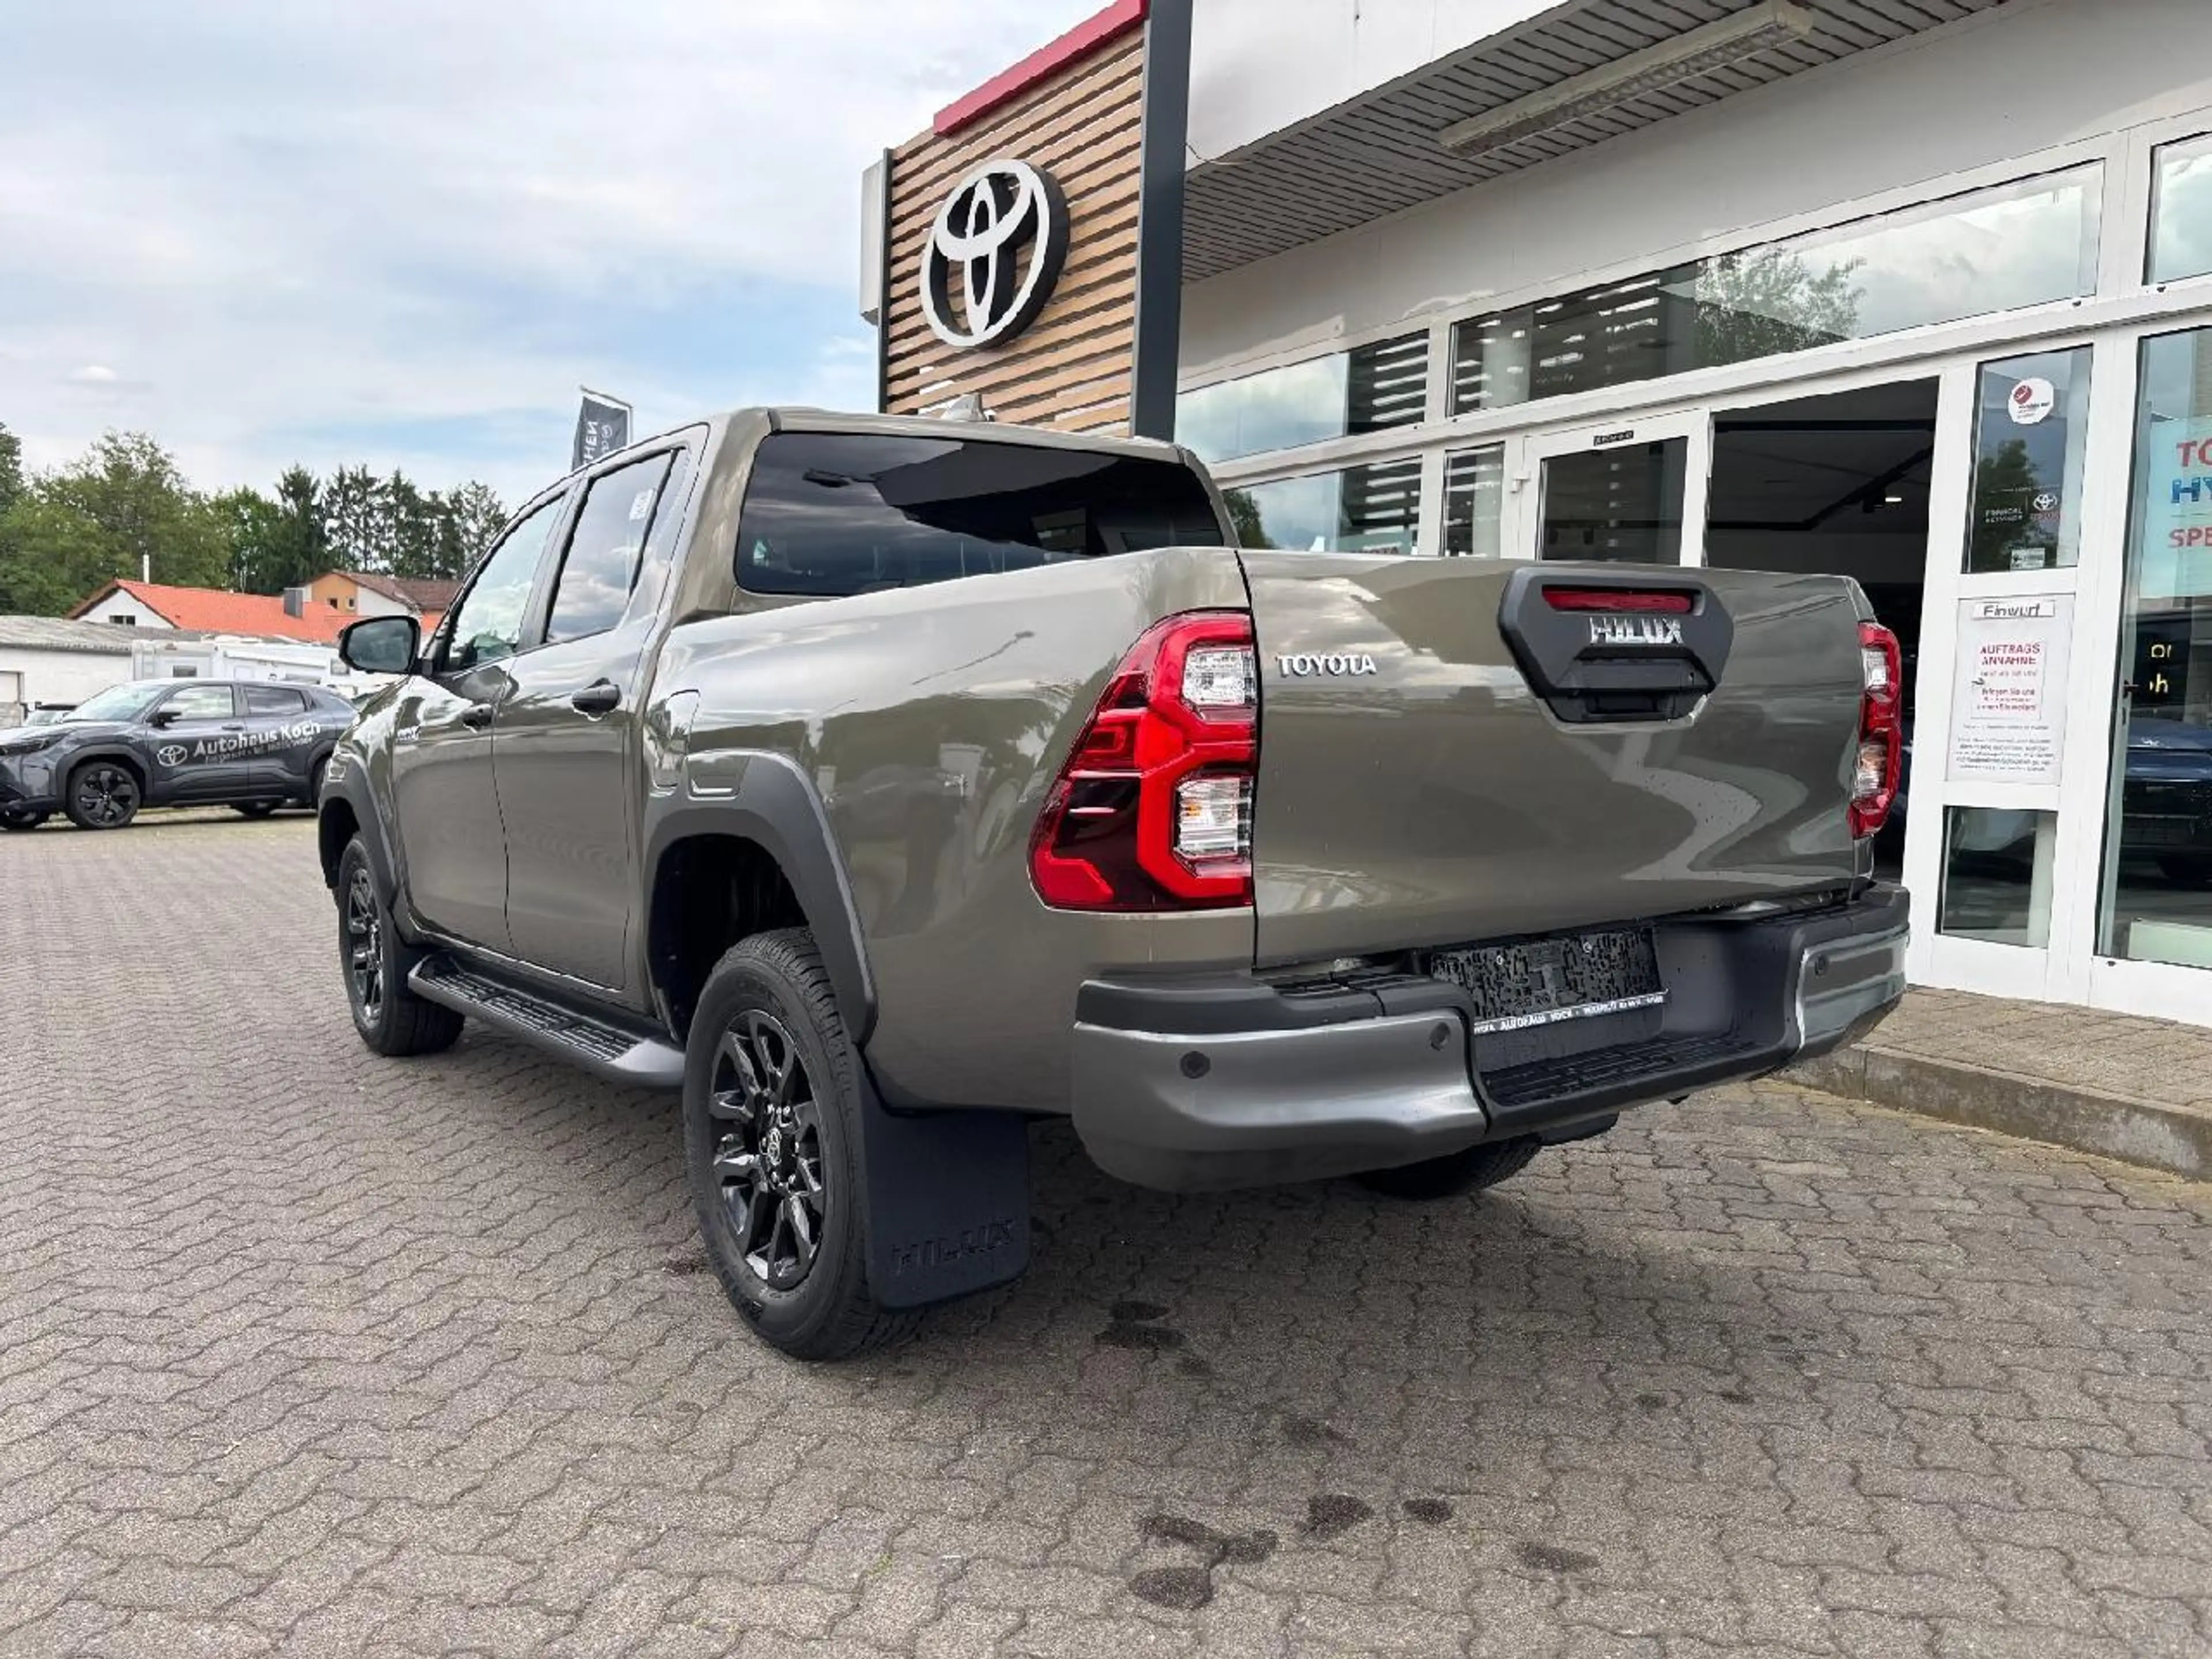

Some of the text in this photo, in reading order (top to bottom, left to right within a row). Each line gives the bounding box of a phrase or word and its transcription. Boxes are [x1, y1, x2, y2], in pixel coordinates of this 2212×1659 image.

[1589, 616, 1684, 645] HILUX
[1980, 643, 2040, 655] AUFTRAGS
[1275, 653, 1377, 678] TOYOTA
[194, 731, 277, 758] Autohaus
[280, 719, 321, 741] Koch
